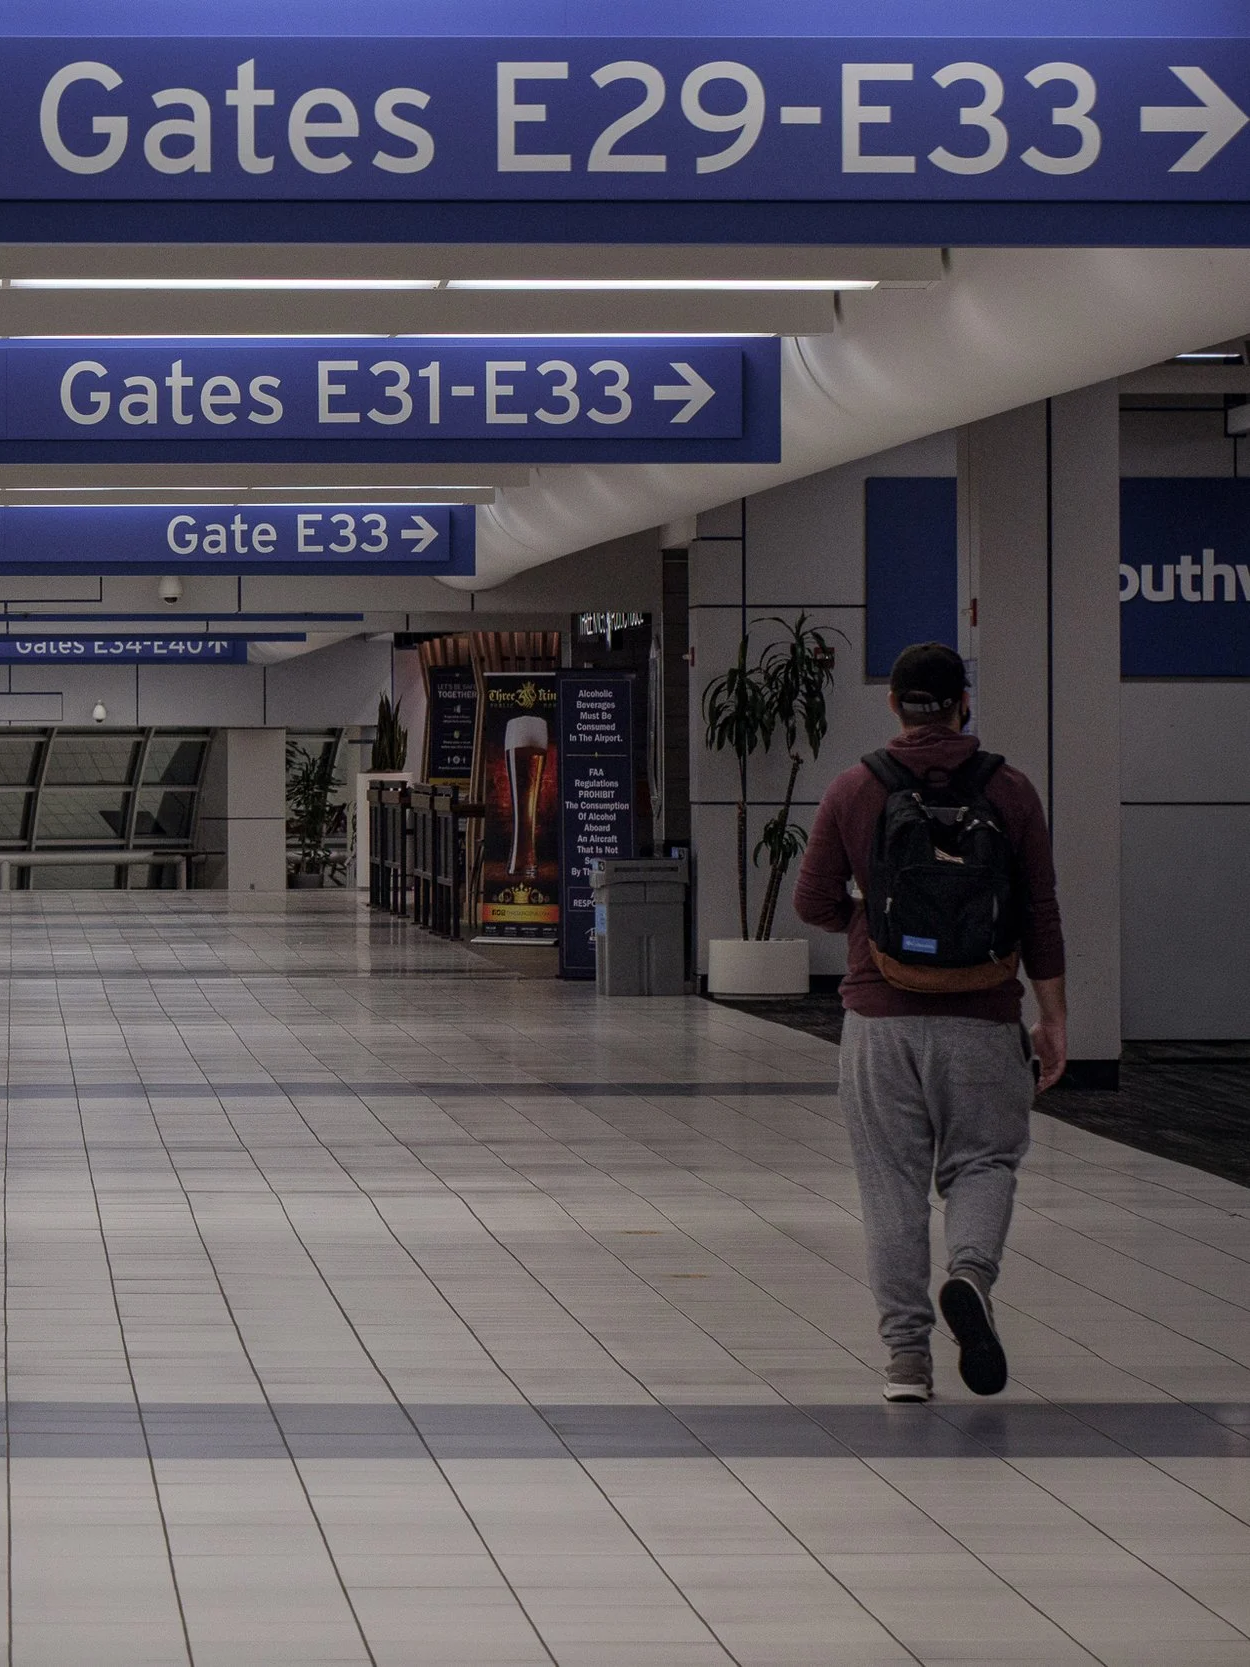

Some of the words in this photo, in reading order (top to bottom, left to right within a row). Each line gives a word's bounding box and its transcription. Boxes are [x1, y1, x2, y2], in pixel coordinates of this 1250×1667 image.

[39, 57, 435, 176] Gates
[496, 60, 1102, 176] E29-E33
[60, 359, 284, 426] Gates
[317, 359, 632, 426] E31-E33
[166, 512, 277, 555] Gate
[297, 513, 389, 554] E33
[1119, 549, 1250, 602] outh
[578, 690, 613, 698] Alcoholic
[576, 701, 616, 710] Beverages
[580, 712, 600, 720] Must
[601, 712, 612, 720] Be
[576, 723, 616, 731] Consumed
[570, 734, 577, 742] In
[579, 734, 592, 742] The
[594, 734, 623, 743] Airport.
[589, 768, 605, 777] FAA
[574, 779, 619, 789] Regulations
[578, 790, 616, 799] PROHIBIT
[565, 801, 579, 810] The
[580, 801, 630, 811] Consumption
[578, 812, 587, 821] Of
[589, 812, 617, 821] Alcohol
[584, 823, 611, 832] Aboard
[577, 835, 588, 843] An
[590, 835, 618, 843] Aircraft
[577, 846, 593, 854] That
[595, 846, 603, 854] Is
[605, 846, 619, 854] Not
[571, 867, 581, 878] By
